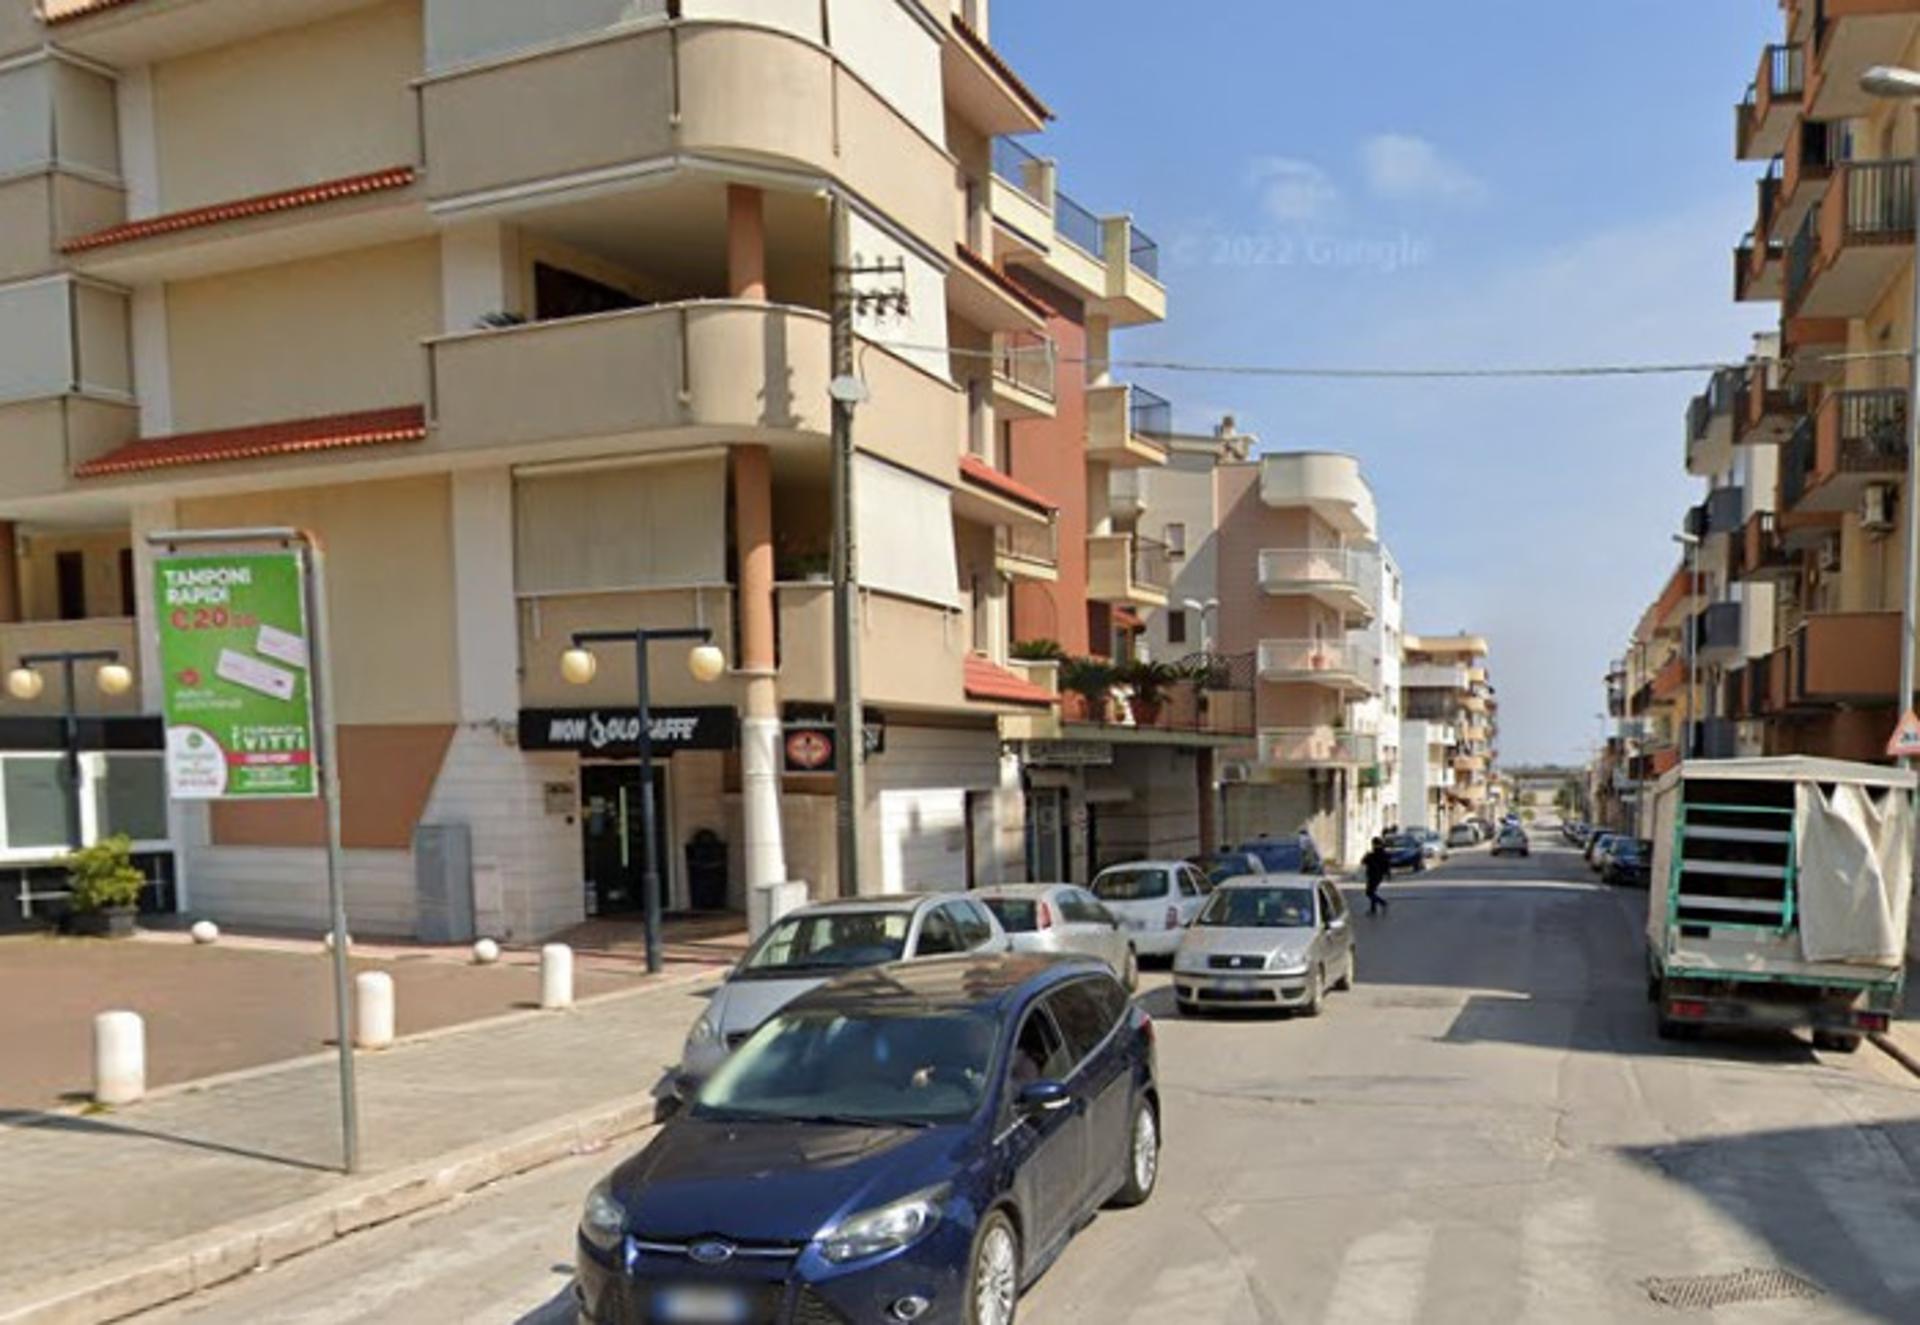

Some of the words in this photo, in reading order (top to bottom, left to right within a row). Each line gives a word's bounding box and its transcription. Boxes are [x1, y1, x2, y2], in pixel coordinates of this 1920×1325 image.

[163, 566, 251, 585] TAMPONI
[166, 586, 230, 605] RAPIDI
[548, 717, 587, 742] NON
